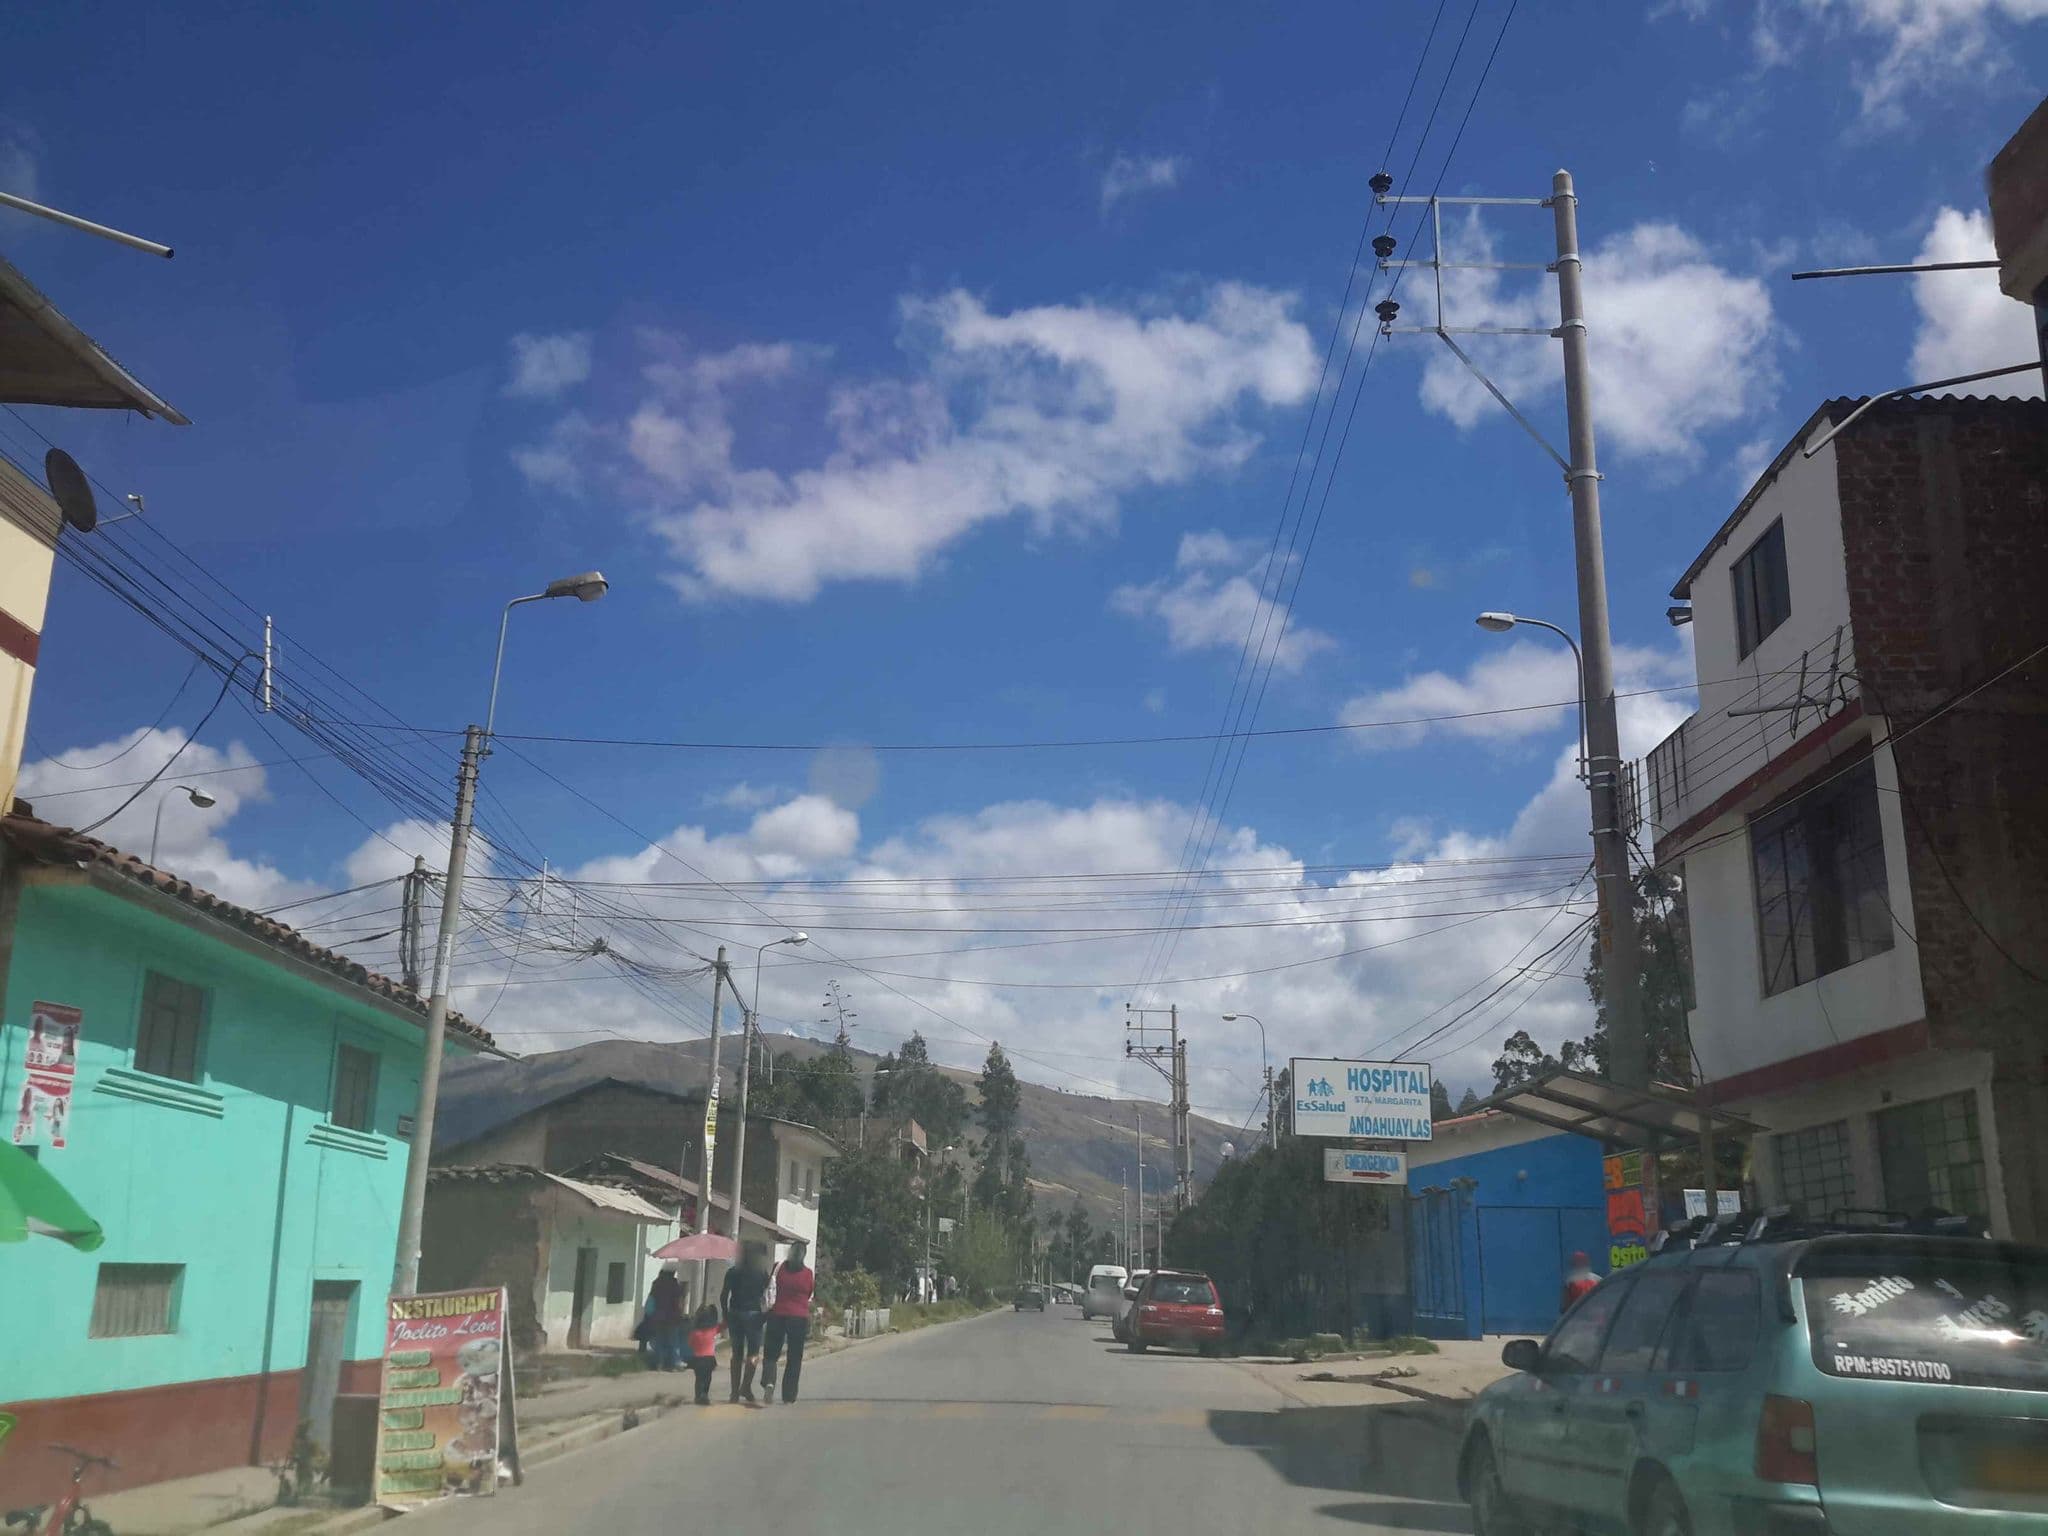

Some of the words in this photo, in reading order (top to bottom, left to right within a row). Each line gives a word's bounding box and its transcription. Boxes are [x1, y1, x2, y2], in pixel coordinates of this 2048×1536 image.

[1347, 1067, 1429, 1095] HOSPITAL
[1297, 1101, 1346, 1112] EsSalud
[1375, 1096, 1423, 1107] MARGARITA
[1349, 1116, 1431, 1138] ANDAHUAYLAS
[1344, 1154, 1399, 1173] EMERGENCIA
[391, 1292, 498, 1320] RESTAURANT
[390, 1321, 448, 1348] Joelito
[453, 1314, 497, 1335] León
[1835, 1355, 1950, 1380] RPM:#957510700
